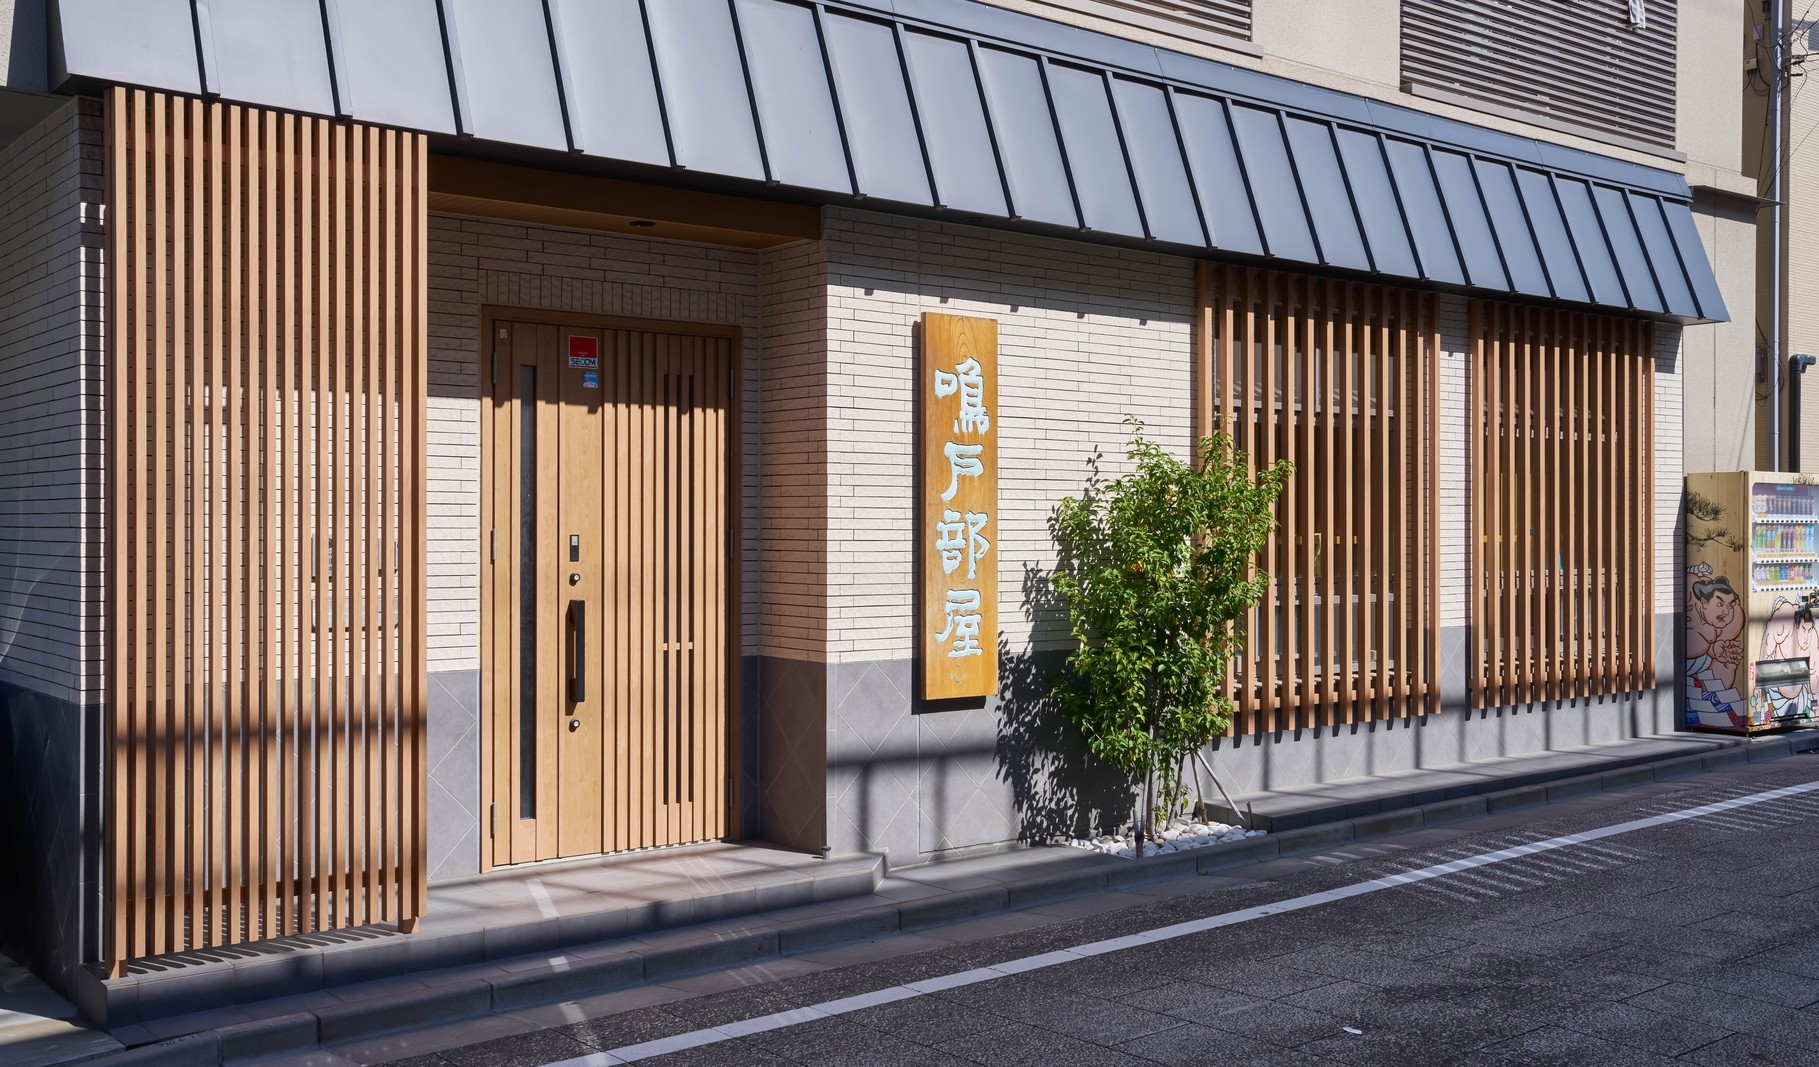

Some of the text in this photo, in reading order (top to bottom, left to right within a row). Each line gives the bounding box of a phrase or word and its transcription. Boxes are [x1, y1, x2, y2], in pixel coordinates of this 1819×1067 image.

[570, 358, 596, 366] SECOM
[934, 357, 990, 658] 鳴戸部屋
